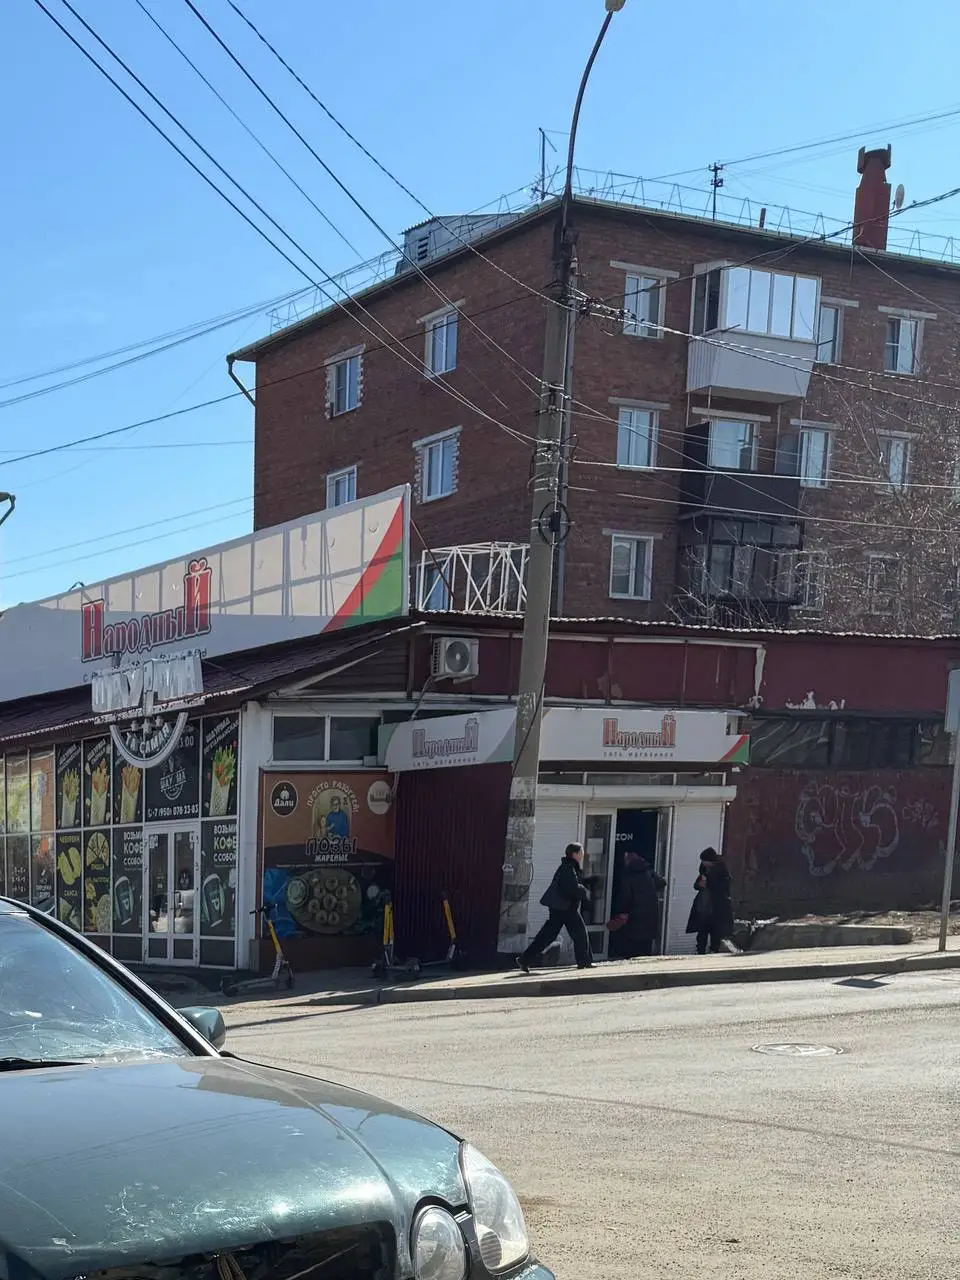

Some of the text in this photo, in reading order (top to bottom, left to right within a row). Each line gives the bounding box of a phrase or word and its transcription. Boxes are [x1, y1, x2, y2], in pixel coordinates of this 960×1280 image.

[123, 842, 144, 854] КОФЕ
[213, 836, 237, 850] КОФЕ
[305, 836, 359, 856] ПОЗЫ
